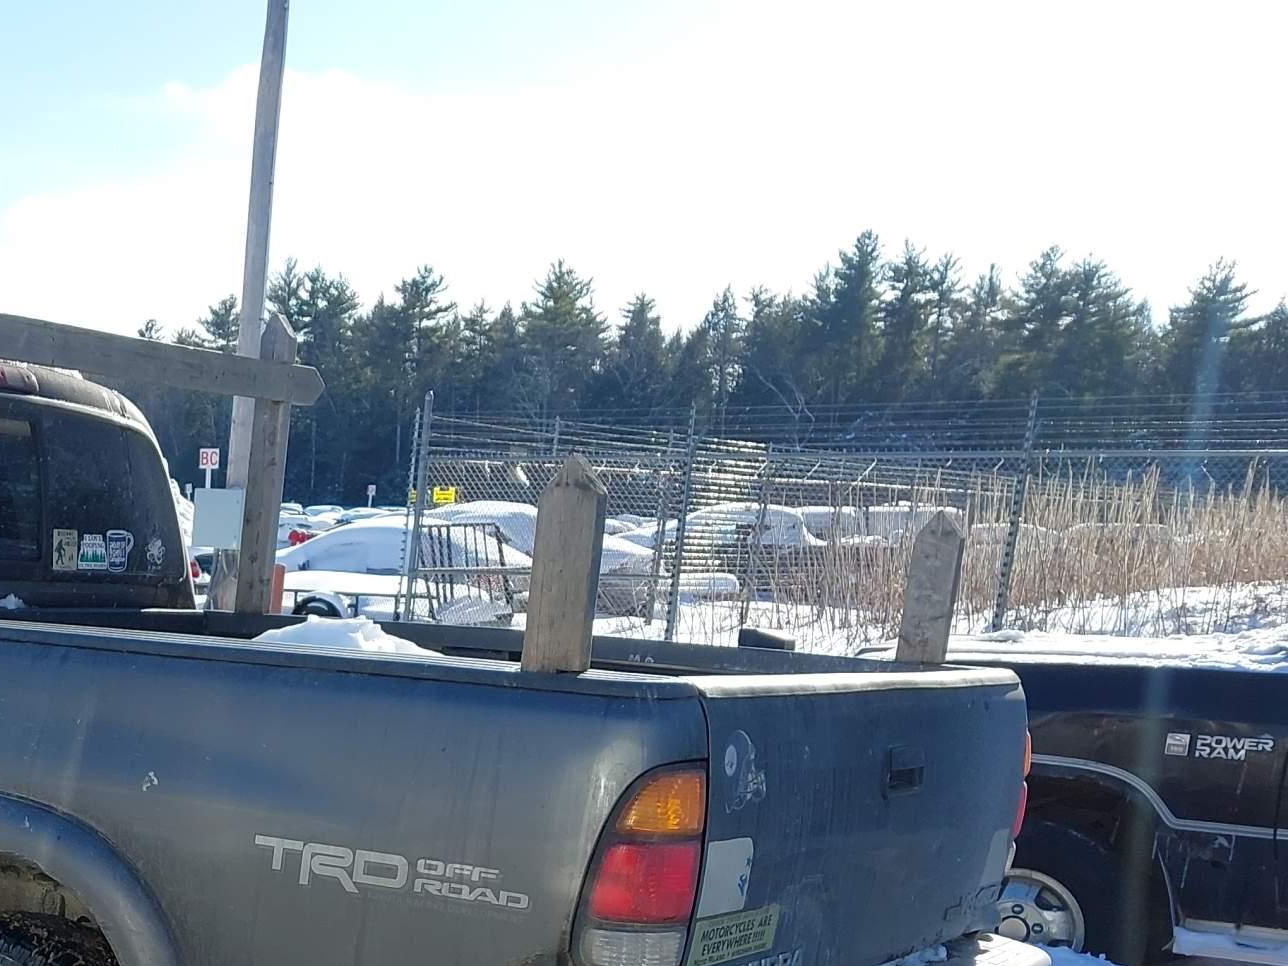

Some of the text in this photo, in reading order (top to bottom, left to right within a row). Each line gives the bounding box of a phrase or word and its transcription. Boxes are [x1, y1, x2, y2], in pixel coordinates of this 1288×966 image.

[201, 451, 218, 466] BC
[1194, 746, 1247, 761] RAM
[1195, 735, 1274, 751] POWER
[254, 834, 409, 893] TRD
[416, 858, 500, 882] OFF
[413, 878, 530, 909] ROAD
[700, 914, 773, 943] MOTORCYCLES ARE
